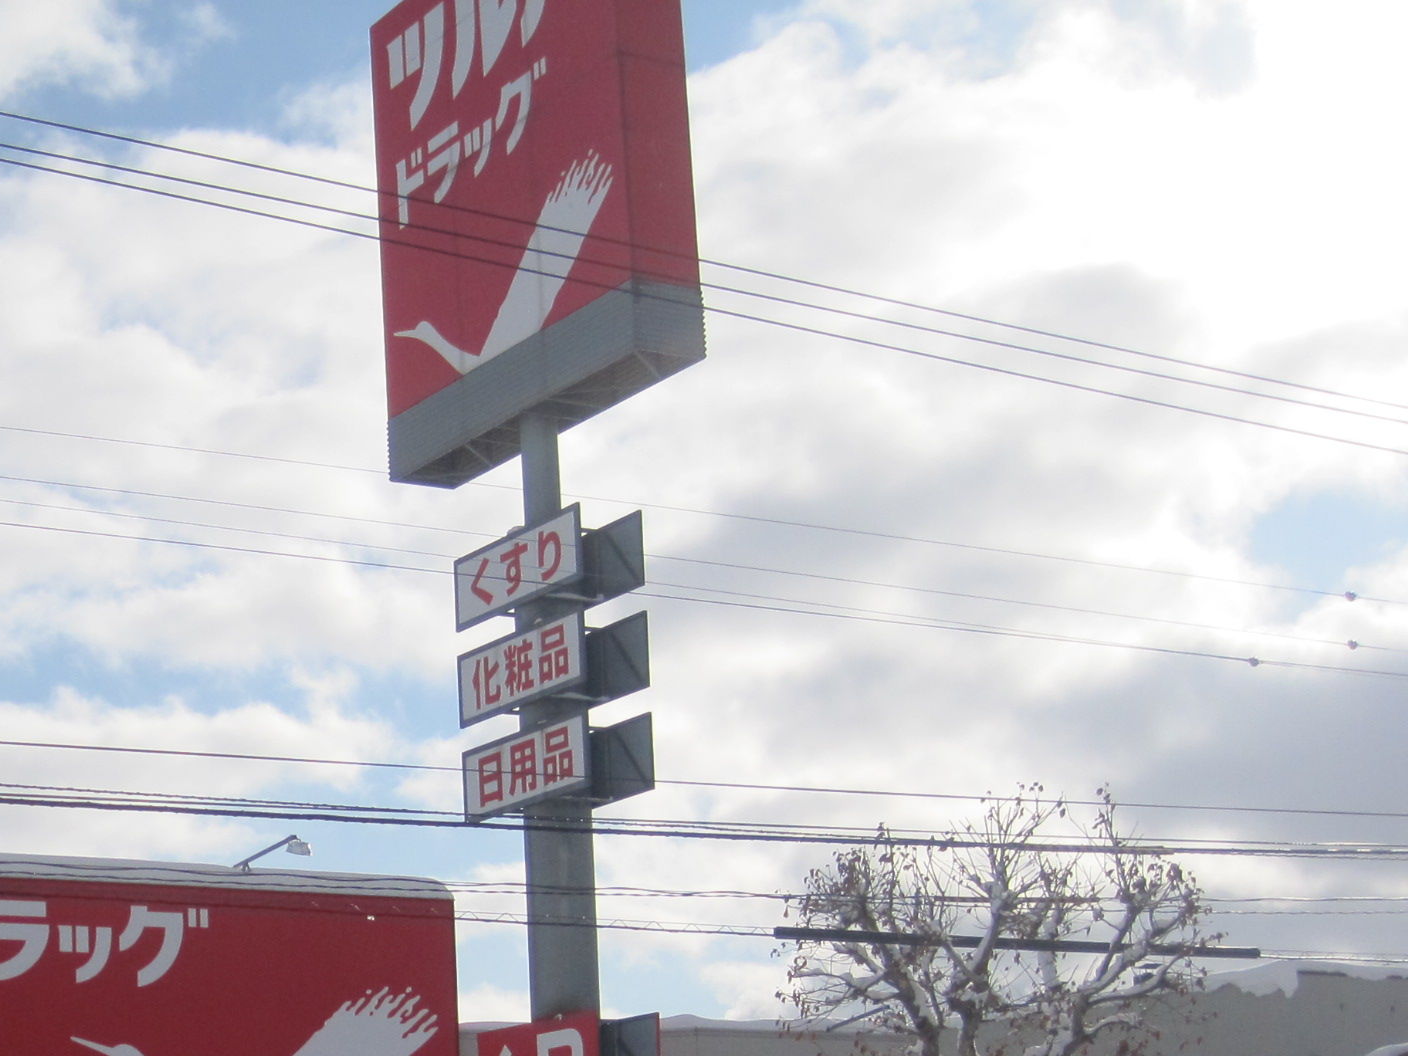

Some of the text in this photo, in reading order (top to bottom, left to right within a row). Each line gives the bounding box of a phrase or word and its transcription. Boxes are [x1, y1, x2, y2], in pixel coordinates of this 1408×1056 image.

[396, 57, 547, 229] ドラッグ
[471, 530, 562, 605] くすり
[472, 623, 569, 711] 化粧品
[478, 725, 573, 808] 日用品
